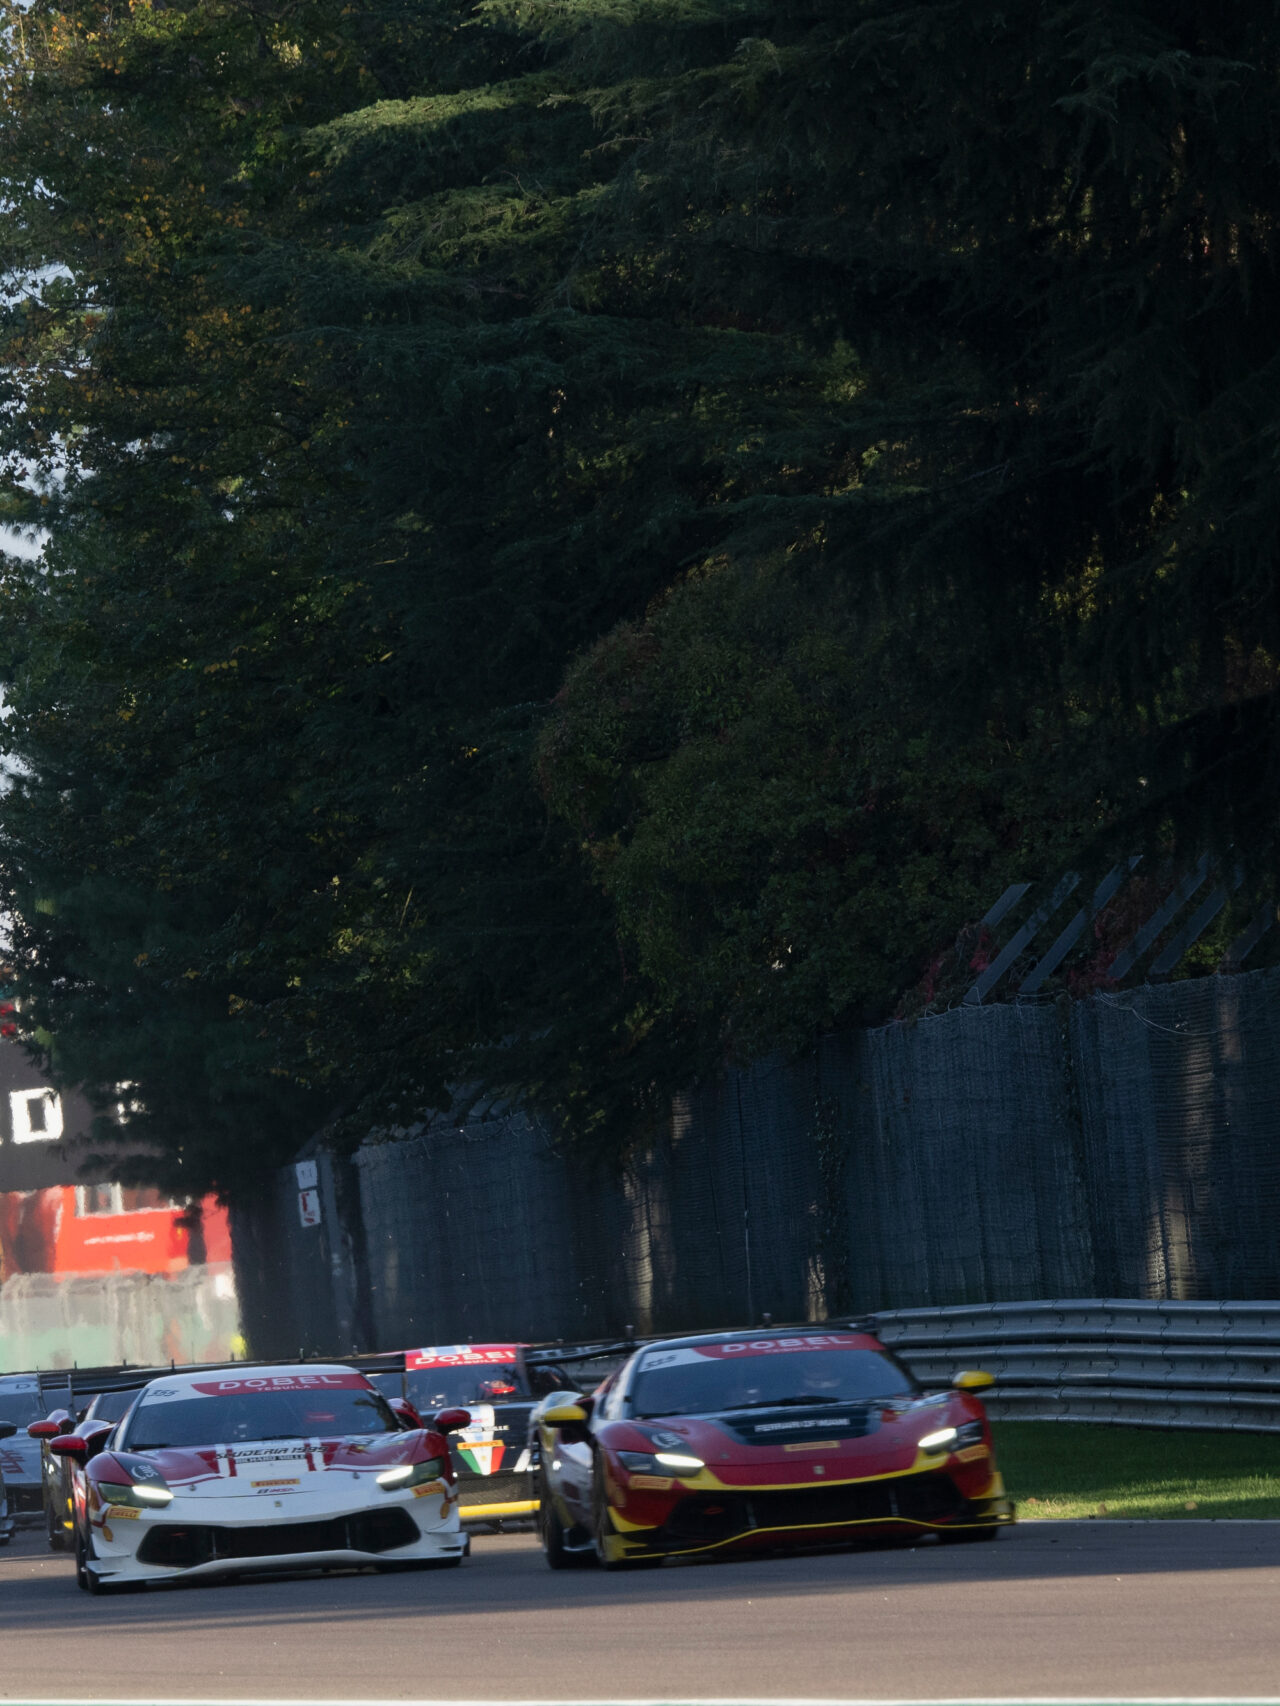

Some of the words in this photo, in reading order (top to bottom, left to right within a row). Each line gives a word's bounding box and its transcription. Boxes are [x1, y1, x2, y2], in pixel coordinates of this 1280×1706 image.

[721, 1335, 854, 1353] DOBEL
[450, 1358, 500, 1366] TEQUILA
[218, 1375, 343, 1390] DOBEL
[110, 1507, 140, 1518] PIRELLI
